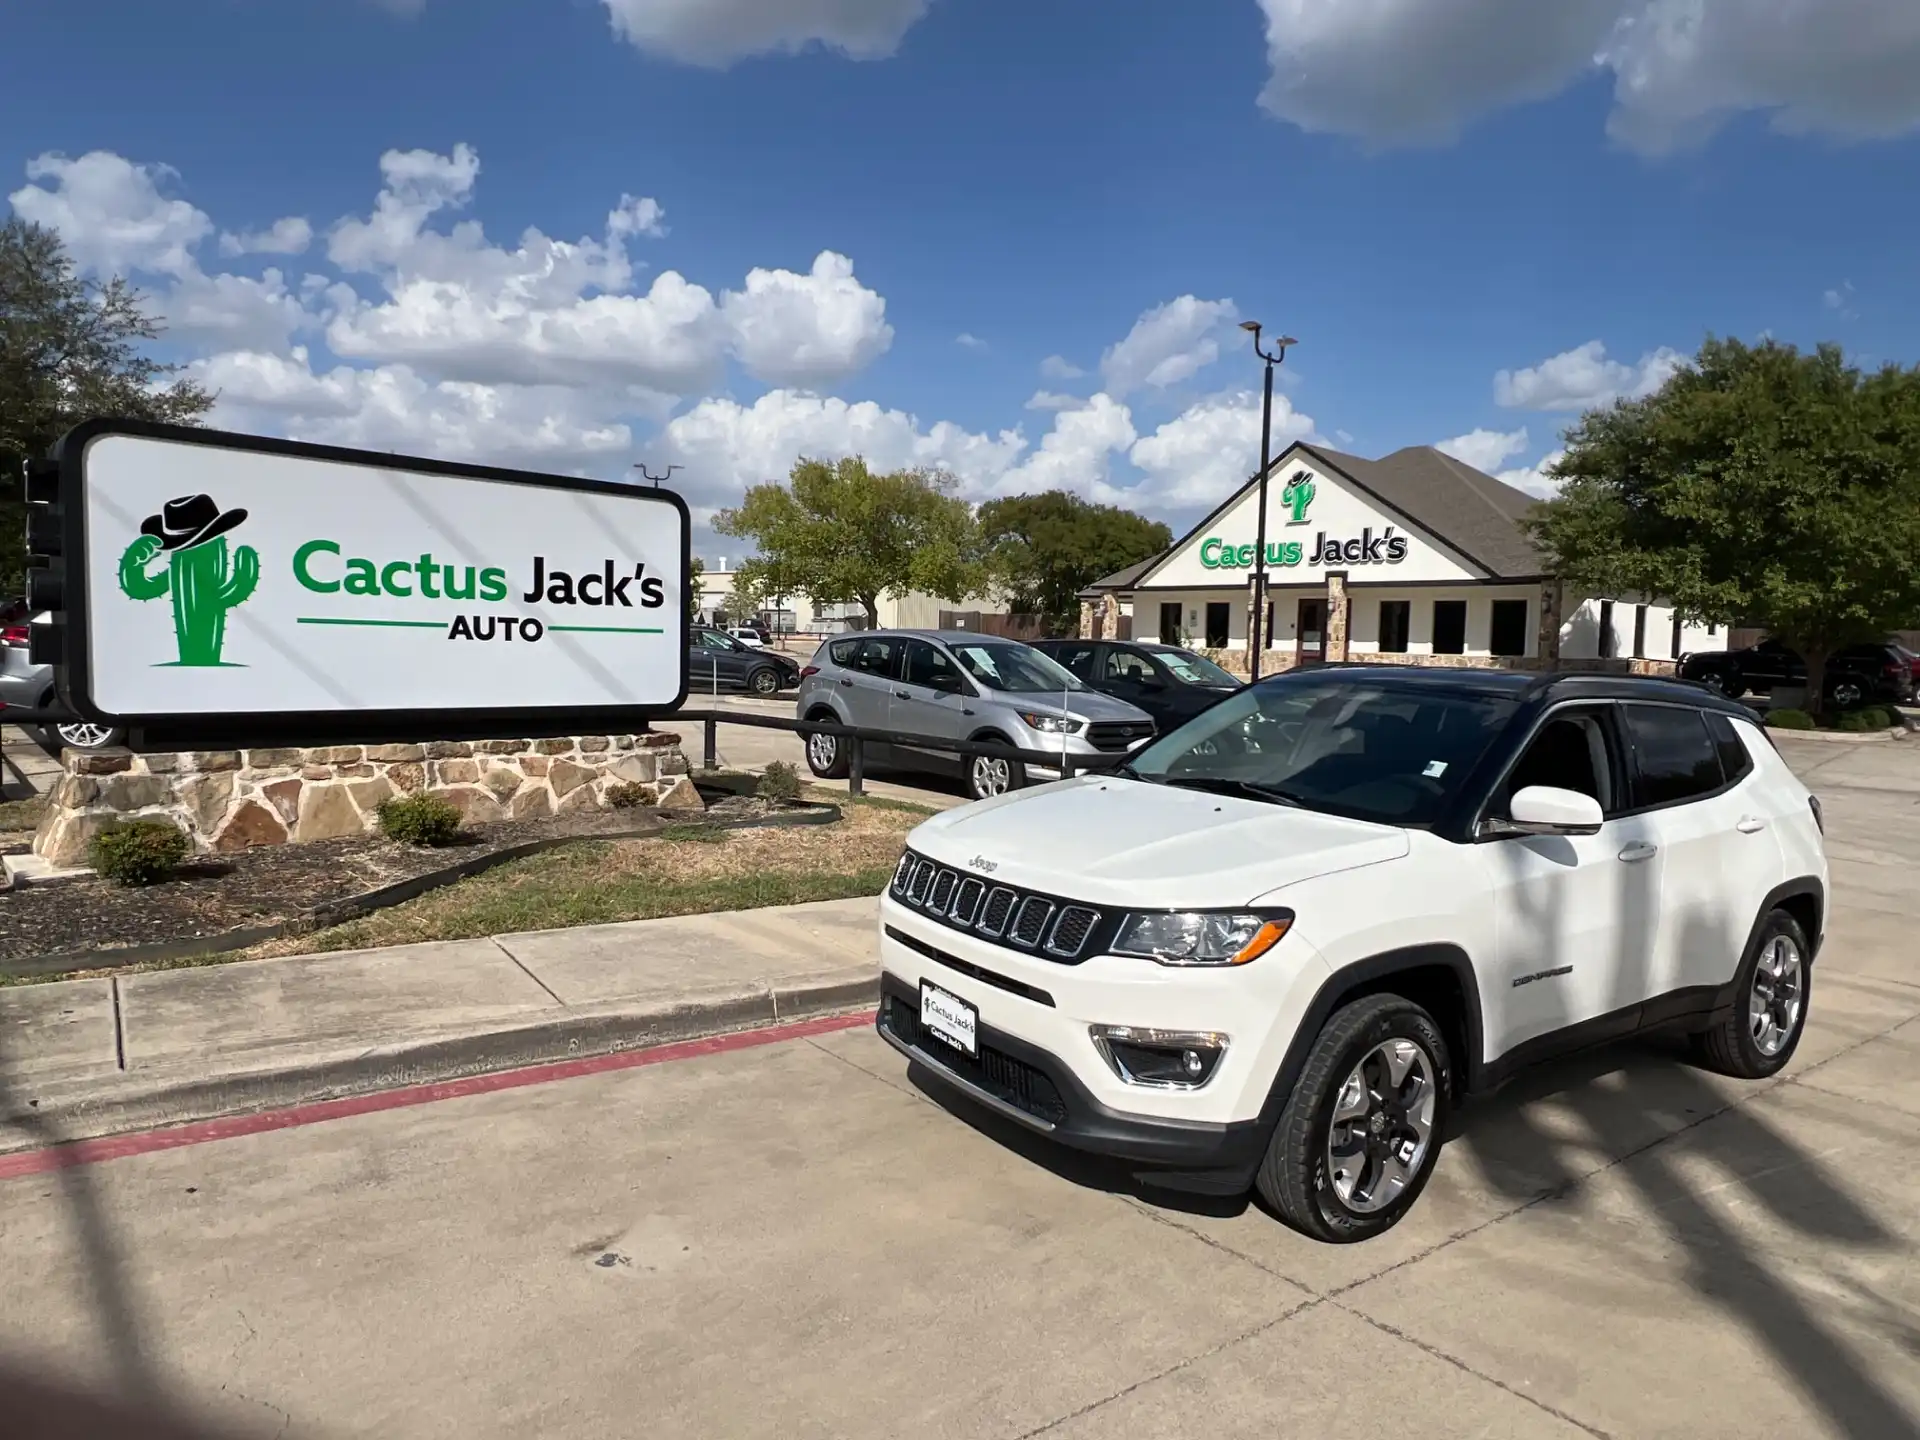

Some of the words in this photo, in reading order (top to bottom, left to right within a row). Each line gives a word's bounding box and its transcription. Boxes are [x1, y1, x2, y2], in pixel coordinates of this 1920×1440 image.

[1310, 527, 1407, 563] Jack's
[293, 540, 507, 601] Cactus
[523, 556, 664, 608] Jack's
[448, 615, 543, 641] AUTO
[930, 1000, 953, 1021] Cactus
